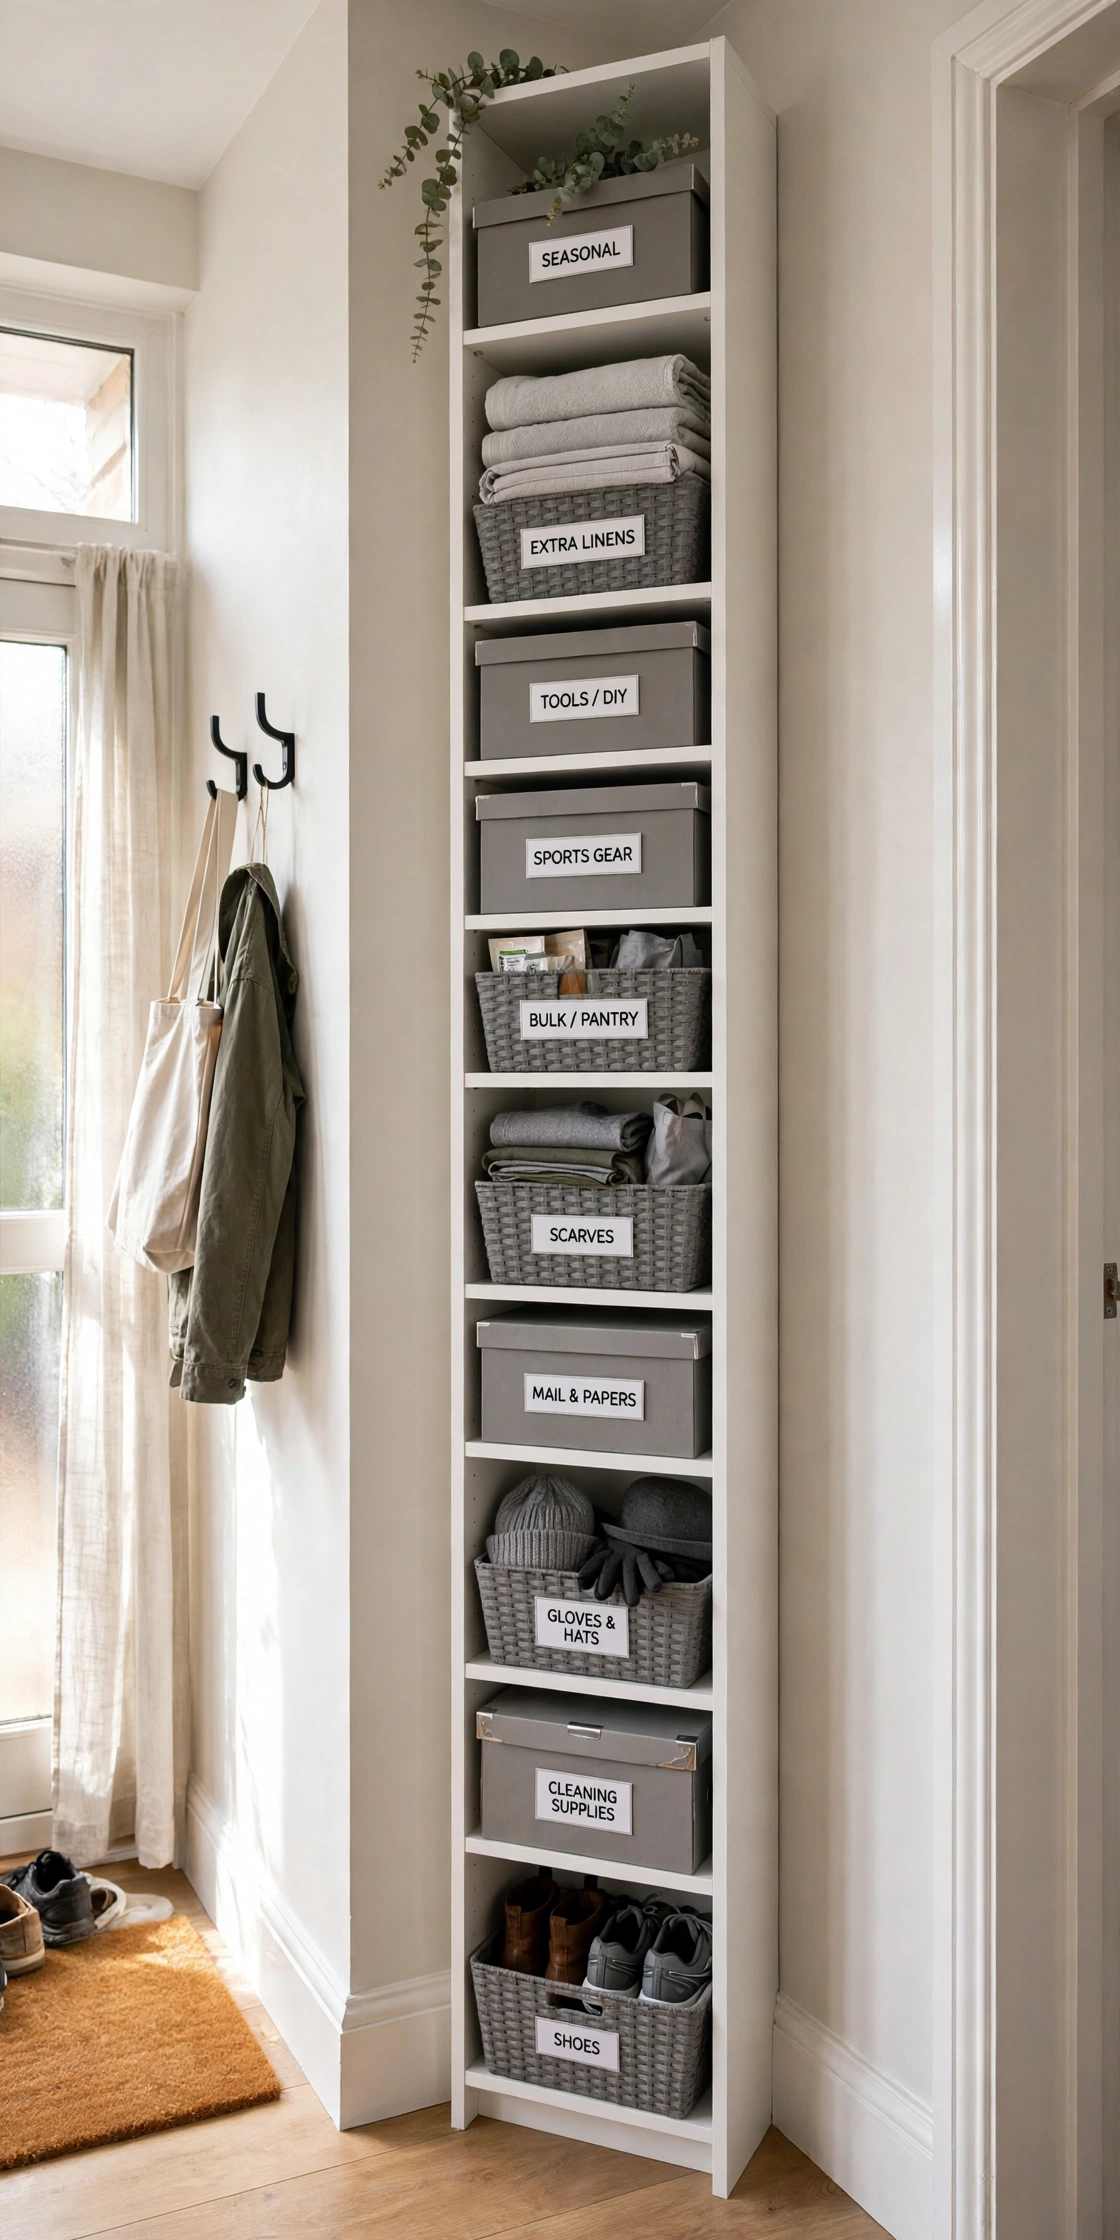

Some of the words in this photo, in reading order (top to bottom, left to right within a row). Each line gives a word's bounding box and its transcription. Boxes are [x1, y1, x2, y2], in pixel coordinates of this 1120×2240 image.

[541, 240, 621, 268] SEASONAL
[530, 535, 579, 555] EXTRA
[582, 528, 636, 550] LINENS
[540, 691, 589, 710] TOOLS
[592, 689, 599, 706] /
[603, 688, 628, 705] DIY
[533, 848, 590, 866] SPORTS
[593, 846, 633, 863] GEAR
[529, 1012, 567, 1028] BULK
[570, 1011, 577, 1028] /
[581, 1010, 639, 1027] PANTRY
[549, 1227, 615, 1244] SCARVES
[532, 1385, 566, 1403] MAIL
[568, 1388, 579, 1403] &
[583, 1389, 637, 1408] PAPERS
[547, 1608, 603, 1629] GLOVES
[605, 1615, 616, 1630] &
[563, 1627, 600, 1646] HATS
[548, 1780, 618, 1805] CLEANING
[551, 1797, 616, 1822] SUPPLIES
[553, 2032, 601, 2056] SHOES
